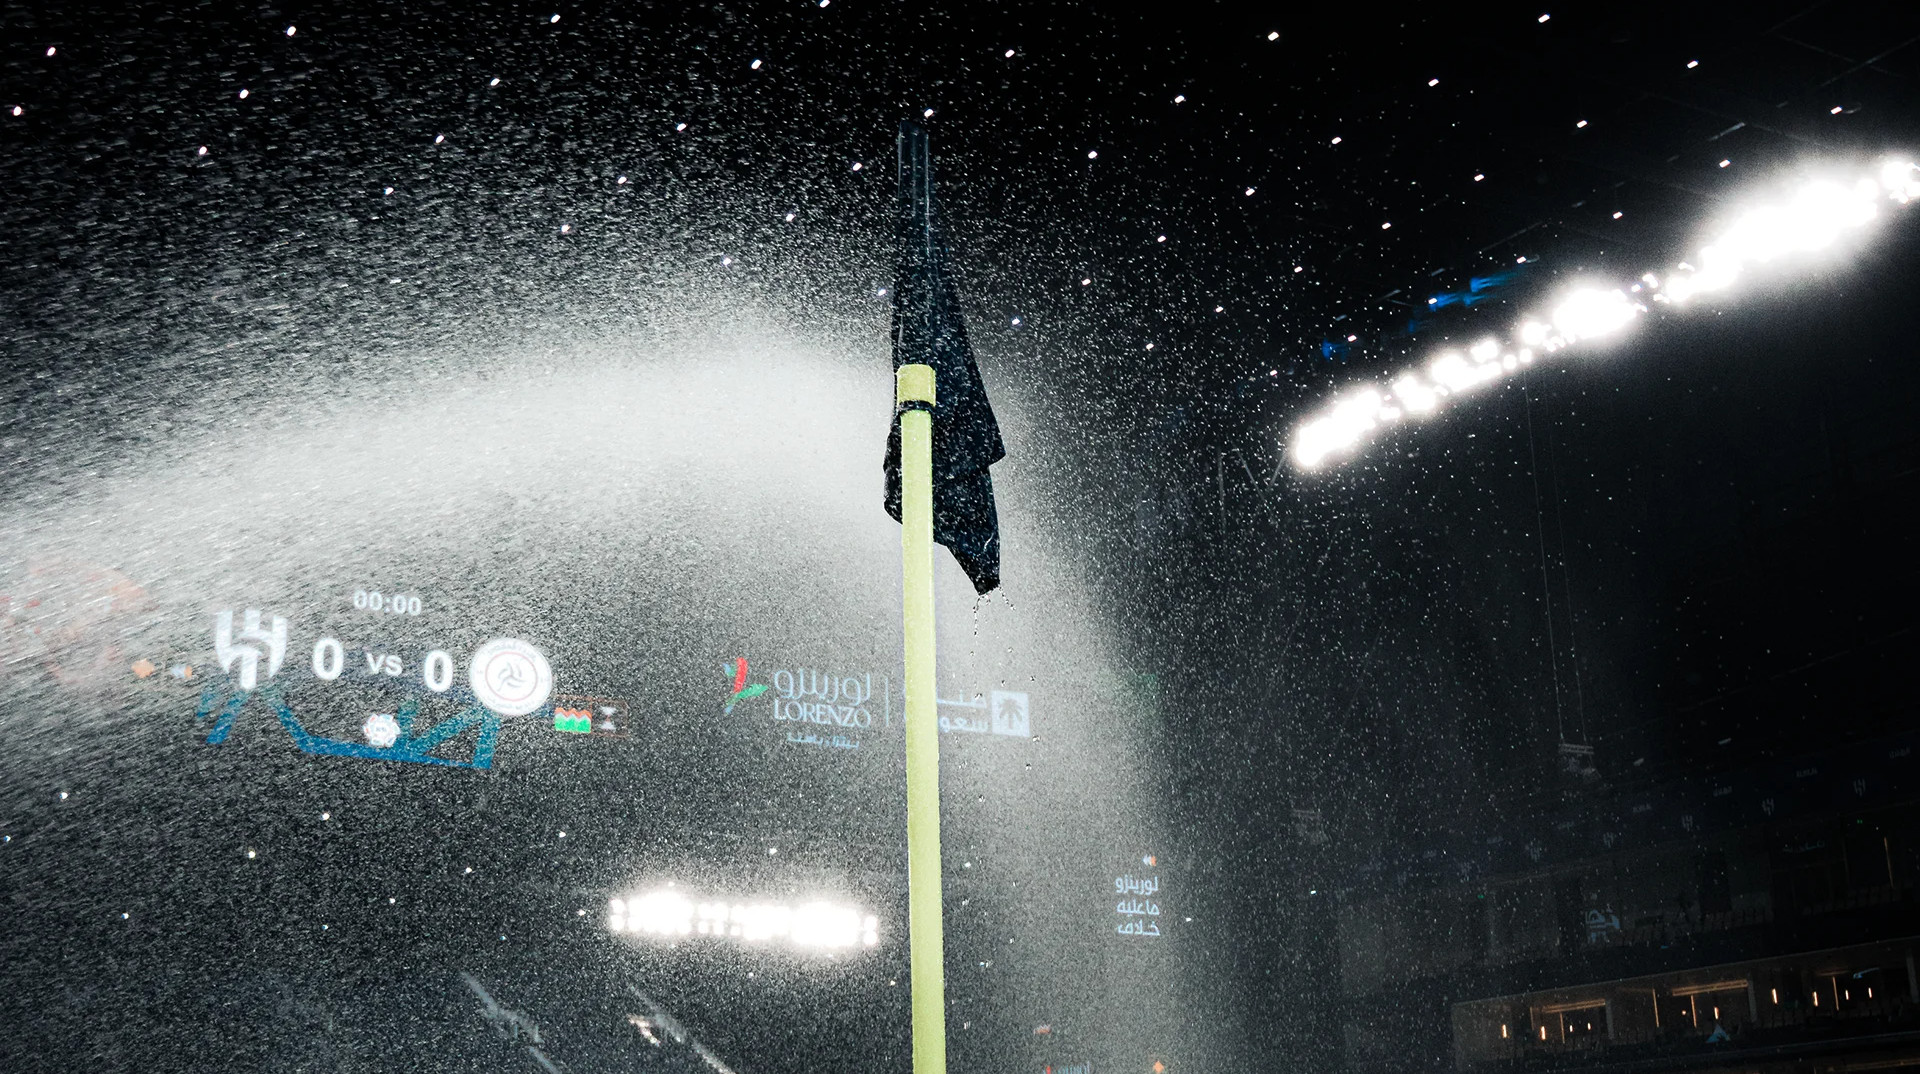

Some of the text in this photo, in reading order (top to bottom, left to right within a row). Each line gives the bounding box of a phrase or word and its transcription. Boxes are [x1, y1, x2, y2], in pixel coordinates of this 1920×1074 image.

[353, 589, 422, 616] 00:00
[312, 637, 344, 681] 0
[424, 650, 453, 692] 0
[774, 699, 871, 728] LORENZO
[1115, 874, 1158, 895] لورينزو
